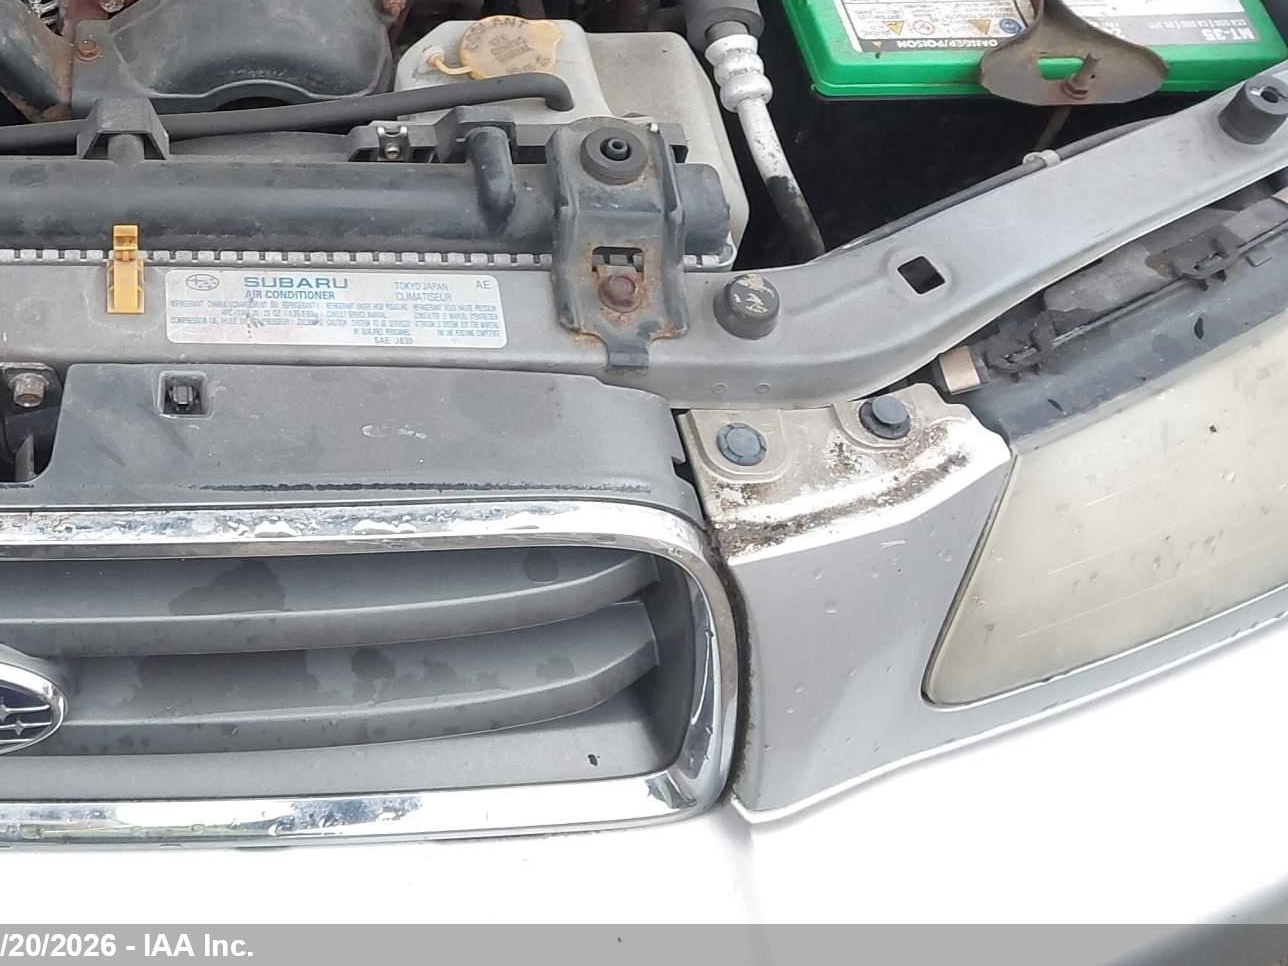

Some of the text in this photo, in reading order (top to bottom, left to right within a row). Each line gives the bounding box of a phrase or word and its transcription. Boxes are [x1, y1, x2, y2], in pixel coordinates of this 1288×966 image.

[1200, 27, 1256, 41] MT-35
[896, 38, 999, 49] DANGER/POISON
[244, 277, 349, 290] SUBARU
[395, 281, 449, 291] TOKYO JAPAN
[476, 280, 491, 289] AE
[245, 290, 336, 300] AIR CONDITIONER
[396, 292, 453, 302] CLIMATISEUR
